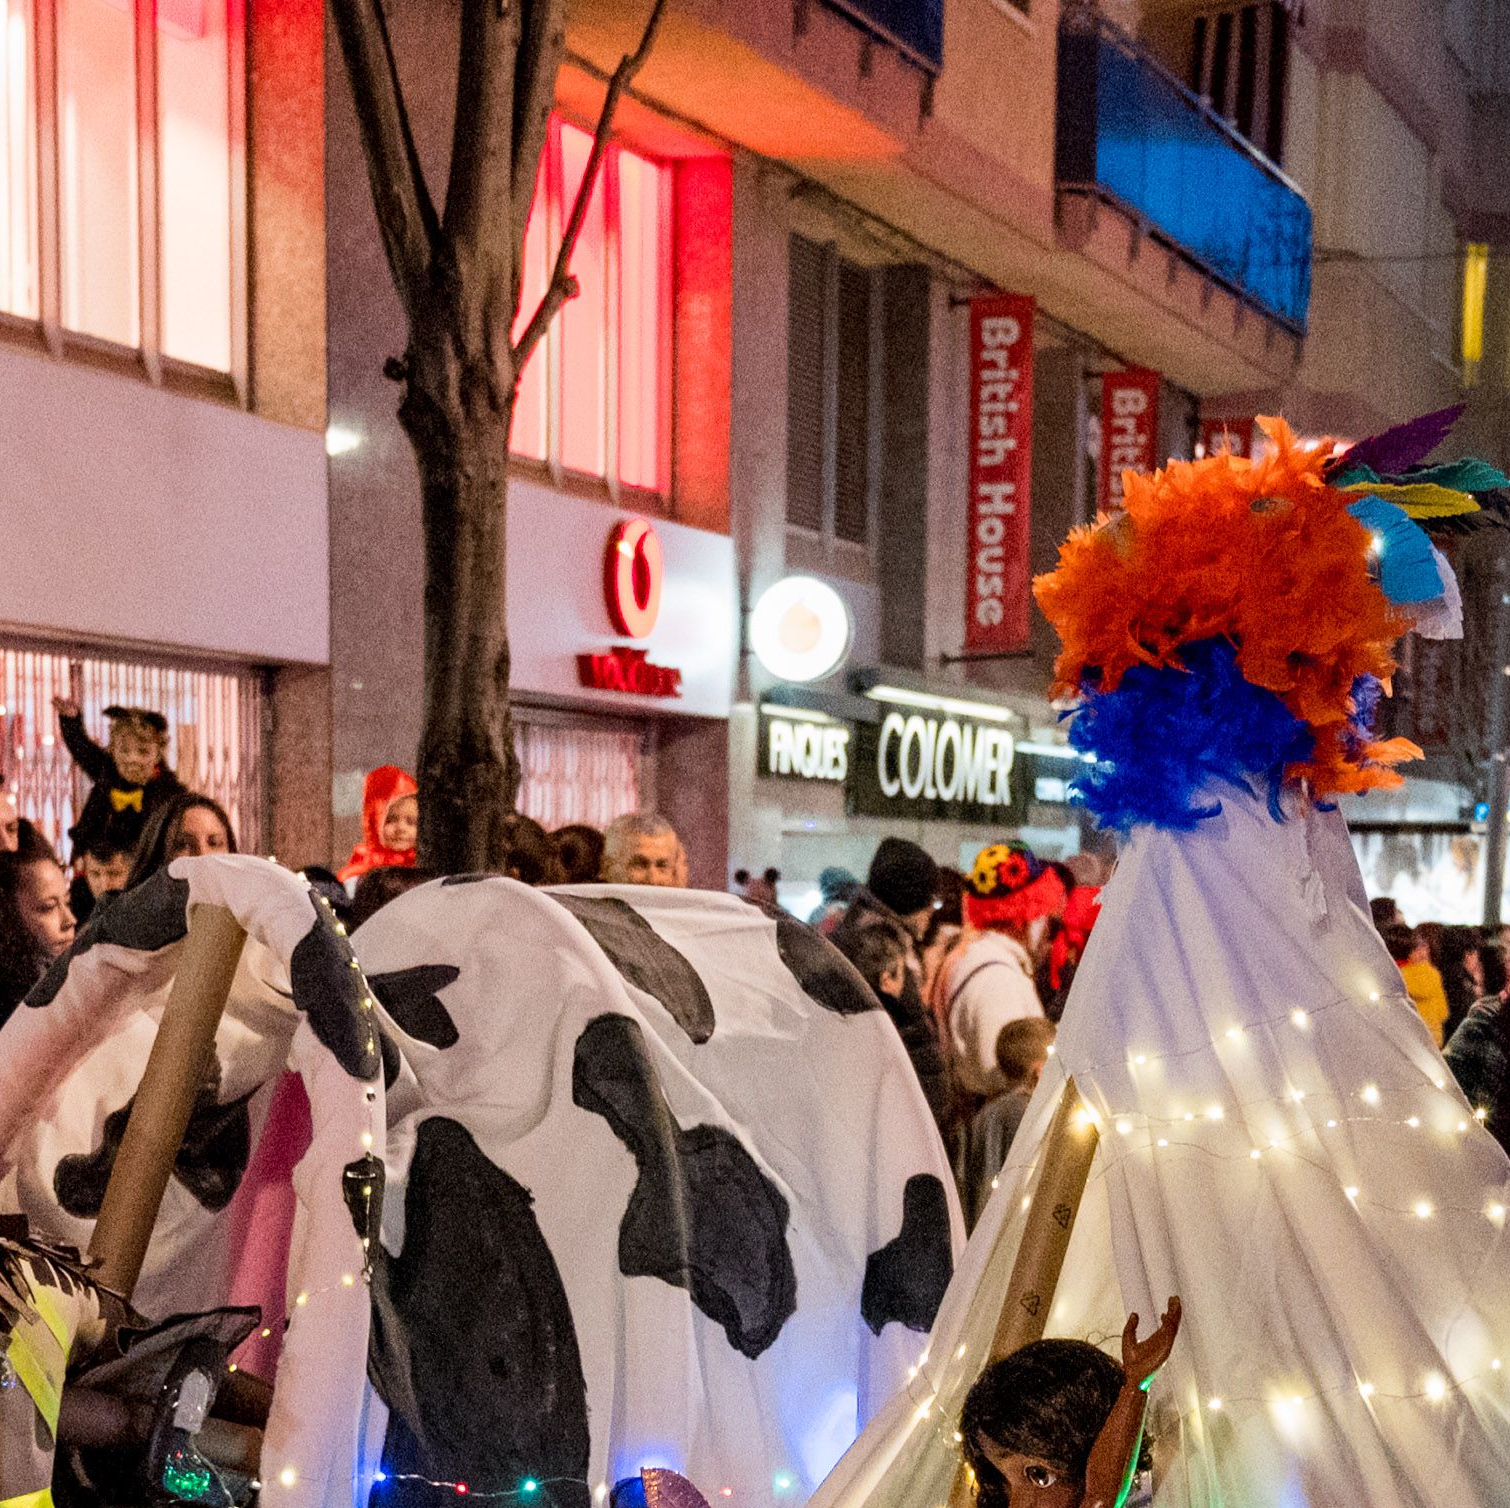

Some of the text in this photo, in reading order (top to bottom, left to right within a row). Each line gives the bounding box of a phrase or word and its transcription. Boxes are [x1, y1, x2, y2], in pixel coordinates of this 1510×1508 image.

[975, 315, 1021, 628] British House
[768, 718, 850, 781] FINQUES
[877, 711, 1015, 806] COLOMER
